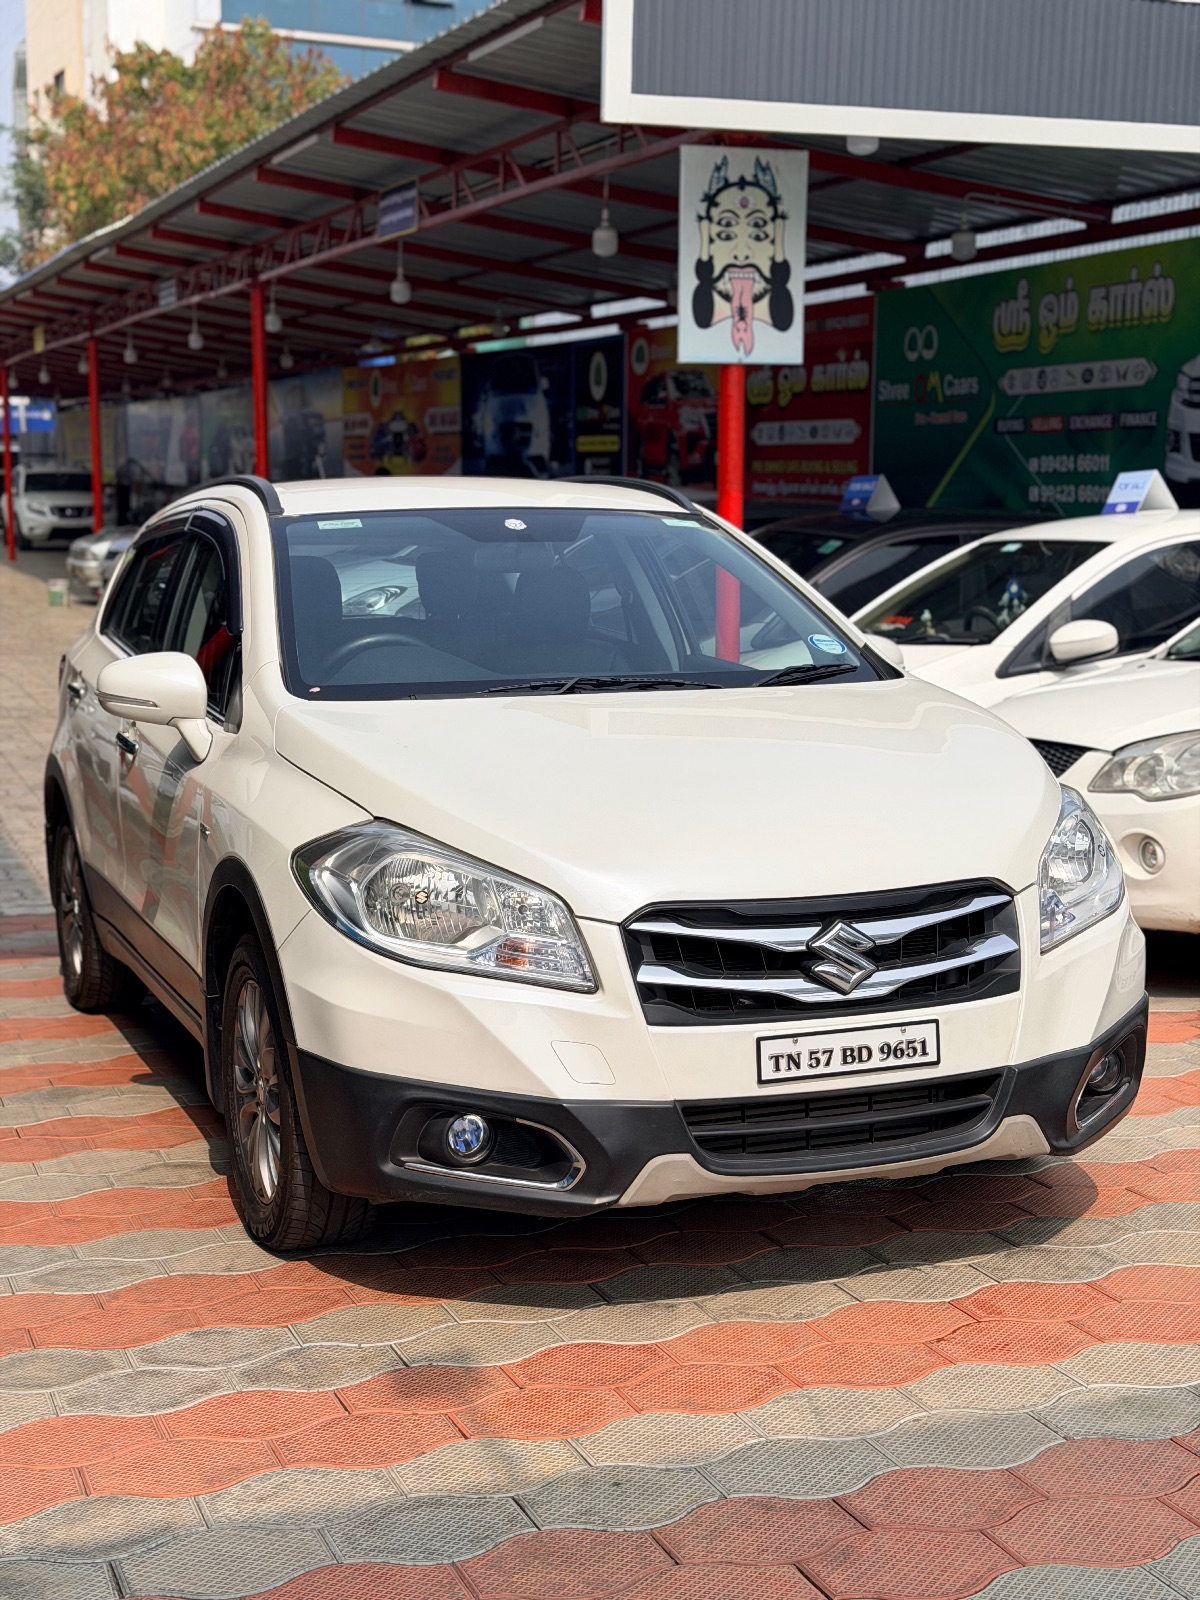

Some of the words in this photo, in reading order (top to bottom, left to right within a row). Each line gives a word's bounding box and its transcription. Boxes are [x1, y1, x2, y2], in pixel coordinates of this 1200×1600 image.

[1087, 261, 1175, 331] கார்ஸ்
[878, 379, 910, 401] Shree
[943, 373, 979, 396] Caars
[1030, 415, 1064, 432] SELLING
[1070, 413, 1113, 430] EXCHANGE
[1120, 411, 1158, 427] FINANCE
[1039, 454, 1075, 473] 99424
[768, 1051, 801, 1073] TN
[807, 1047, 834, 1069] 57
[840, 1044, 873, 1066] BD
[878, 1037, 929, 1062] 9651
